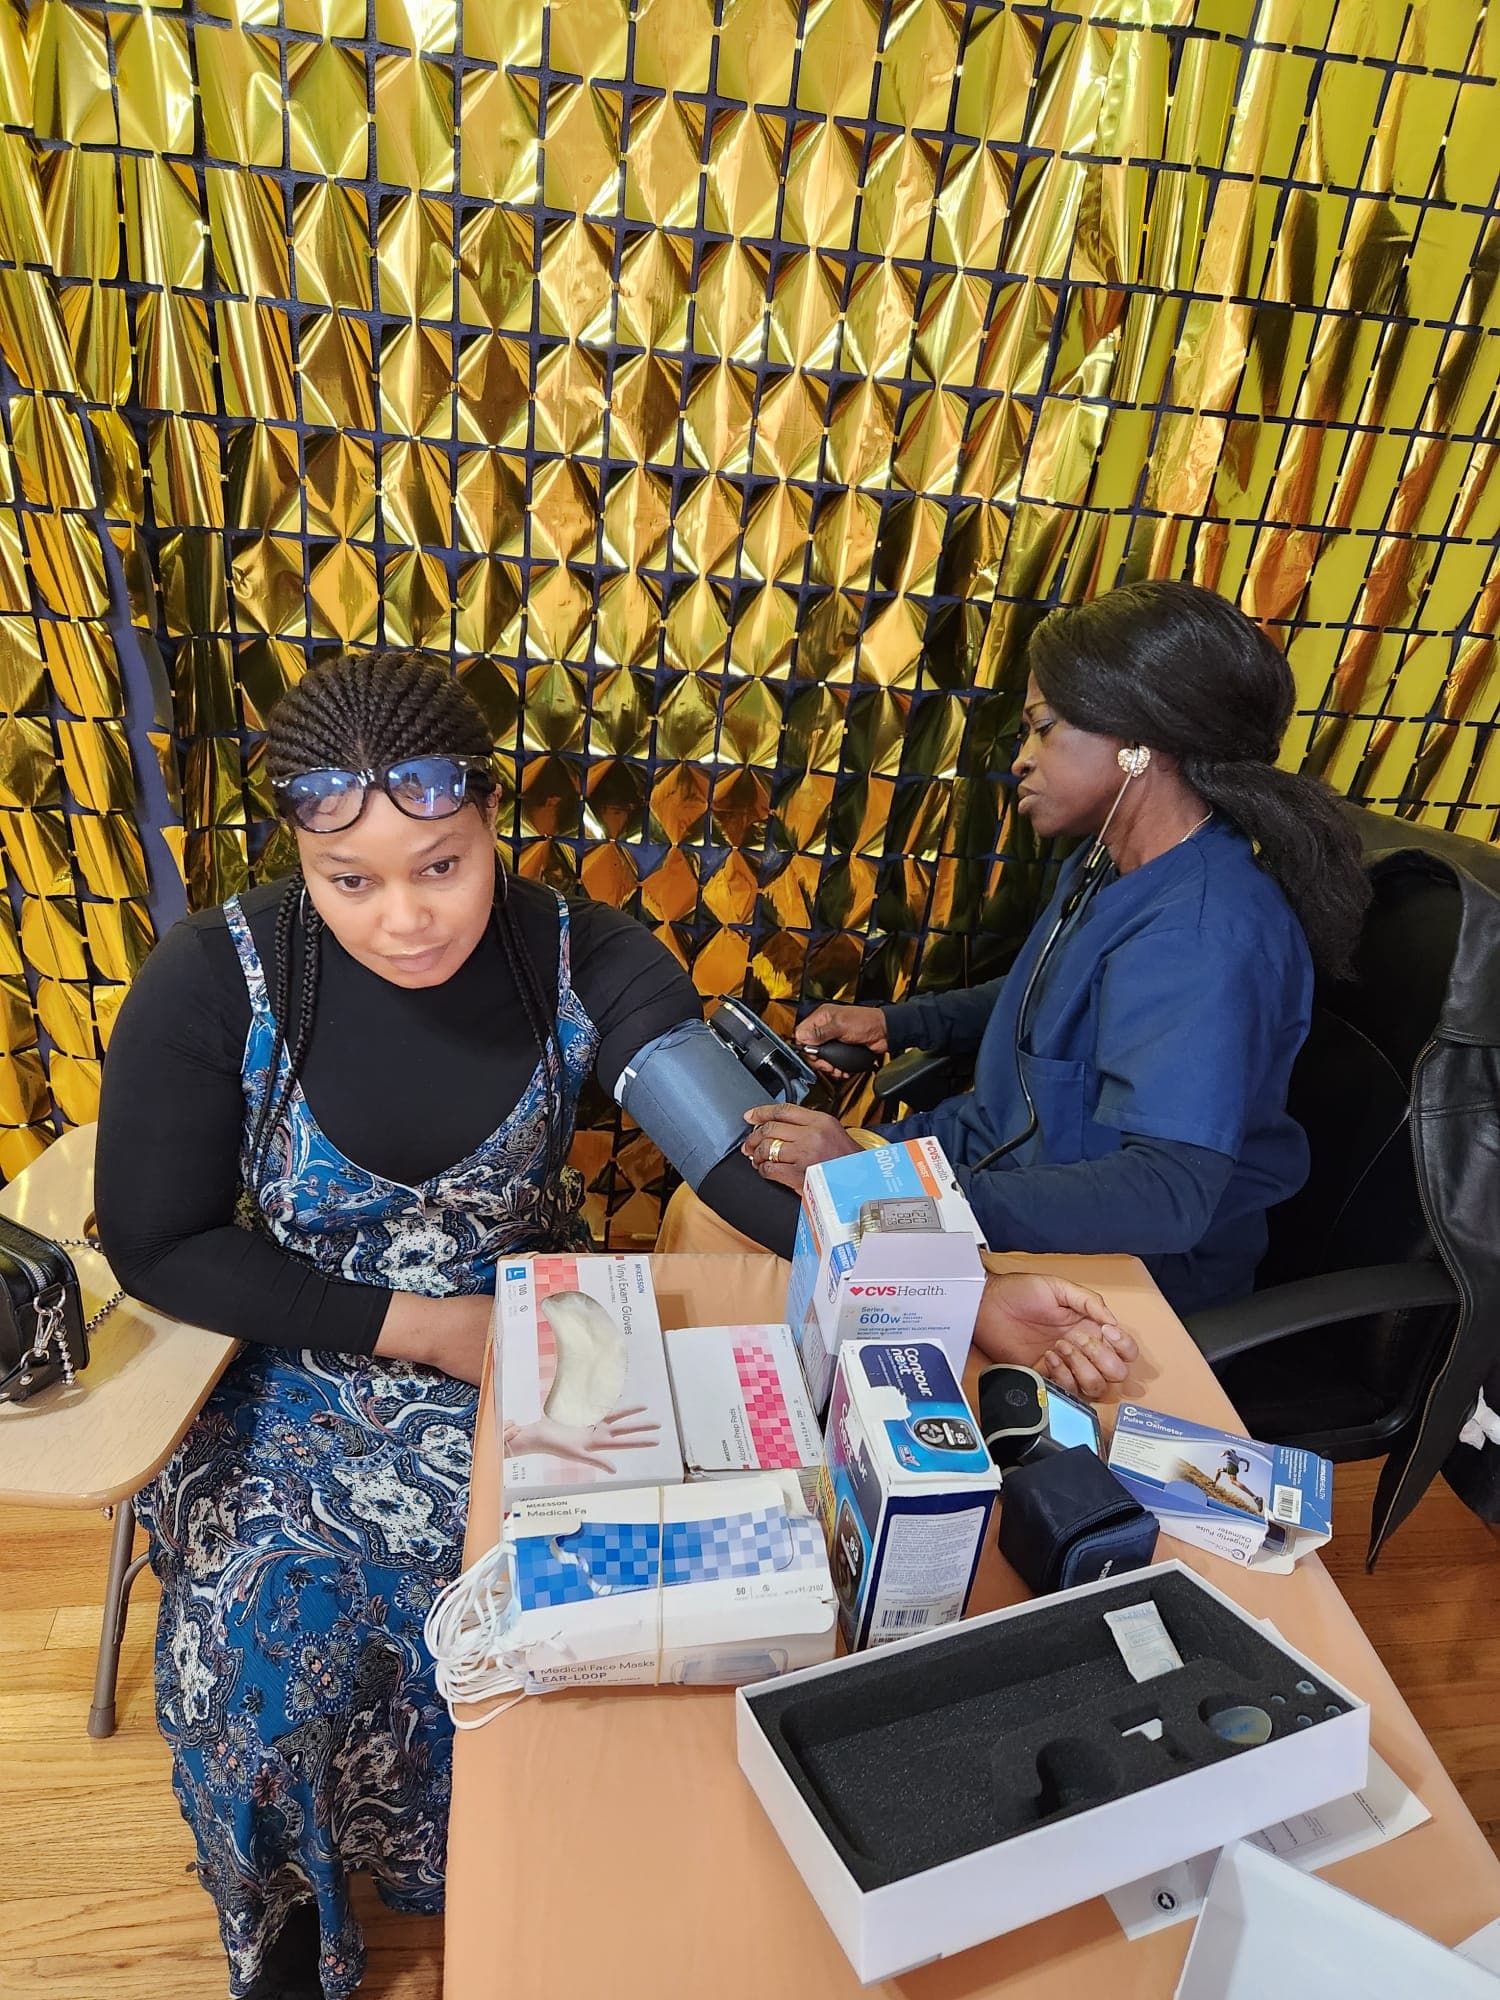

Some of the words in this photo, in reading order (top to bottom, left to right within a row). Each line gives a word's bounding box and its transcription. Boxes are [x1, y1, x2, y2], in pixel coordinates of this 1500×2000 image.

[874, 1149, 895, 1178] 600w
[615, 1263, 627, 1282] Vinyl
[518, 1283, 527, 1296] 100
[618, 1282, 630, 1304] Exam
[621, 1305, 633, 1336] Gloves
[860, 1313, 901, 1324] 600w
[891, 1348, 911, 1376] next
[903, 1347, 933, 1397] Contour
[733, 1423, 742, 1439] Prep
[1123, 1415, 1144, 1425] Pulse
[1145, 1420, 1184, 1436] Oximeter
[735, 1440, 748, 1461] Alcohol
[527, 1508, 572, 1517] Medical
[1195, 1525, 1215, 1536] Pulse
[1216, 1528, 1252, 1543] Oximeter
[1216, 1533, 1250, 1549] Fingertip
[736, 1586, 746, 1595] 50
[540, 1664, 587, 1675] Medical
[590, 1663, 617, 1671] Face
[619, 1660, 656, 1670] Masks
[541, 1672, 608, 1683] EAR-LOOP
